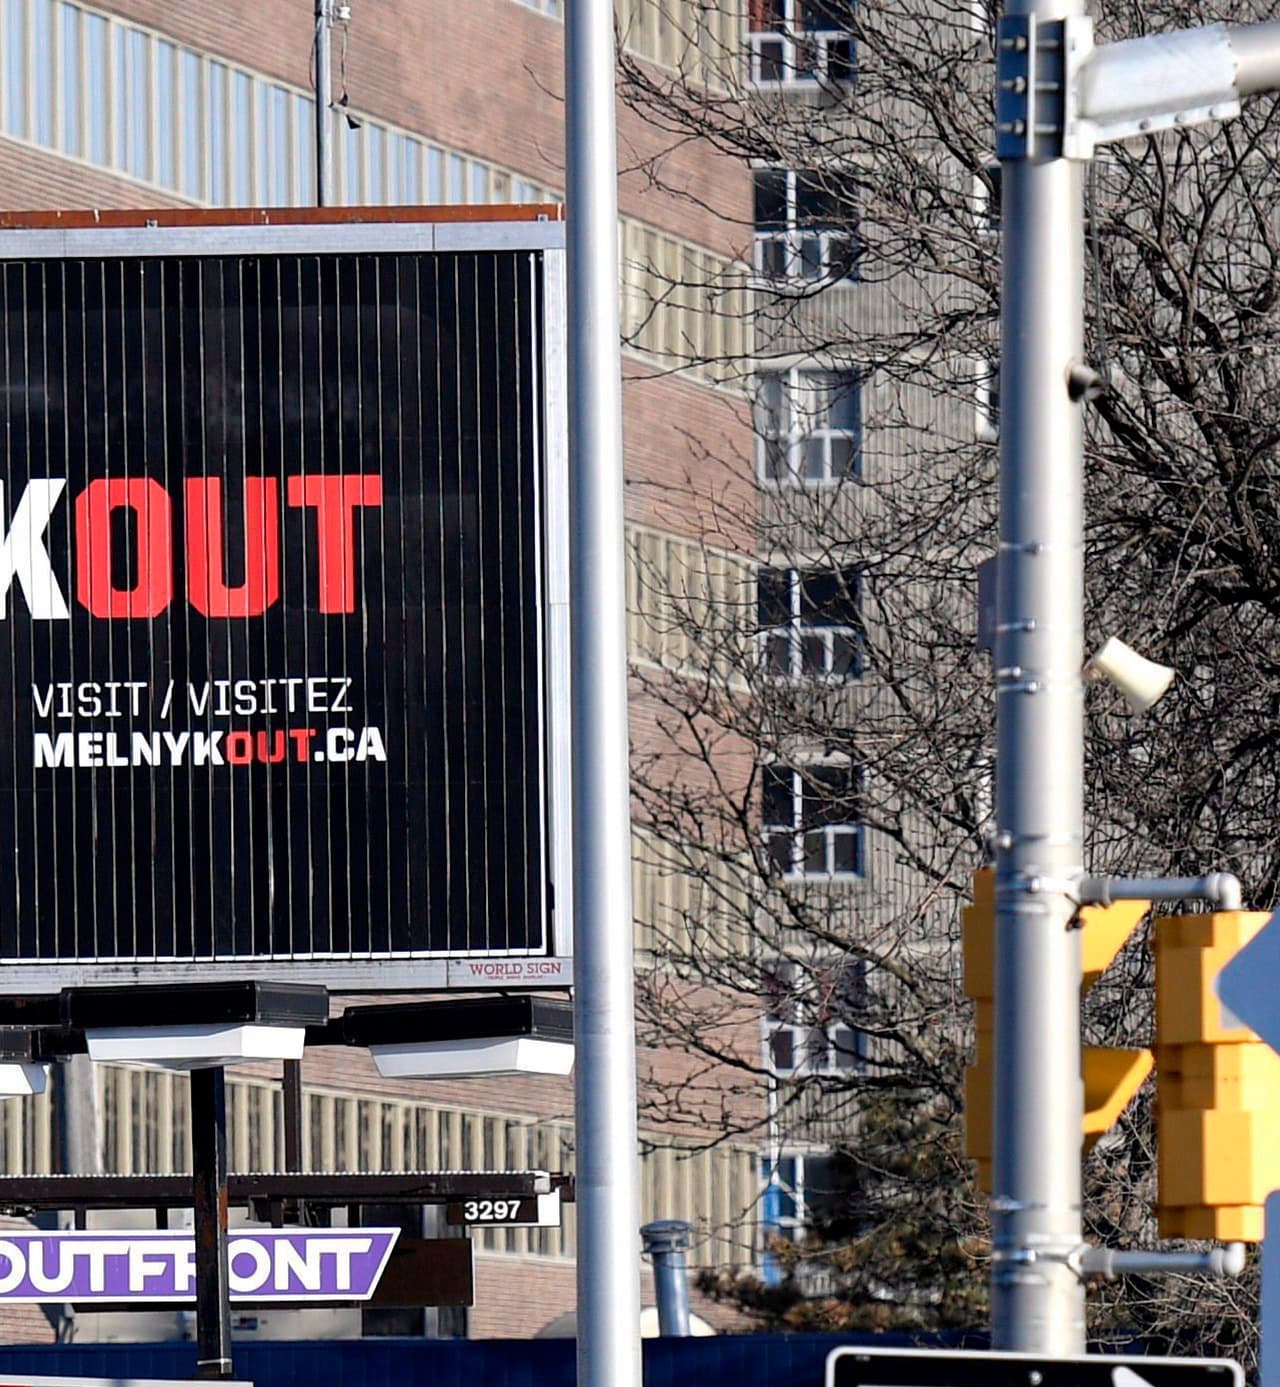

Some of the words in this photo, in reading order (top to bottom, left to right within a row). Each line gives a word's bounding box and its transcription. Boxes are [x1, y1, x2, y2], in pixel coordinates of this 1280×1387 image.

[32, 681, 148, 718] VISIT
[160, 679, 175, 719] /
[187, 677, 353, 716] VISITEZ
[32, 726, 387, 768] MELNYKOUT.CA
[470, 963, 523, 975] WORLD
[527, 962, 562, 974] SIGN
[463, 1199, 521, 1221] 3297
